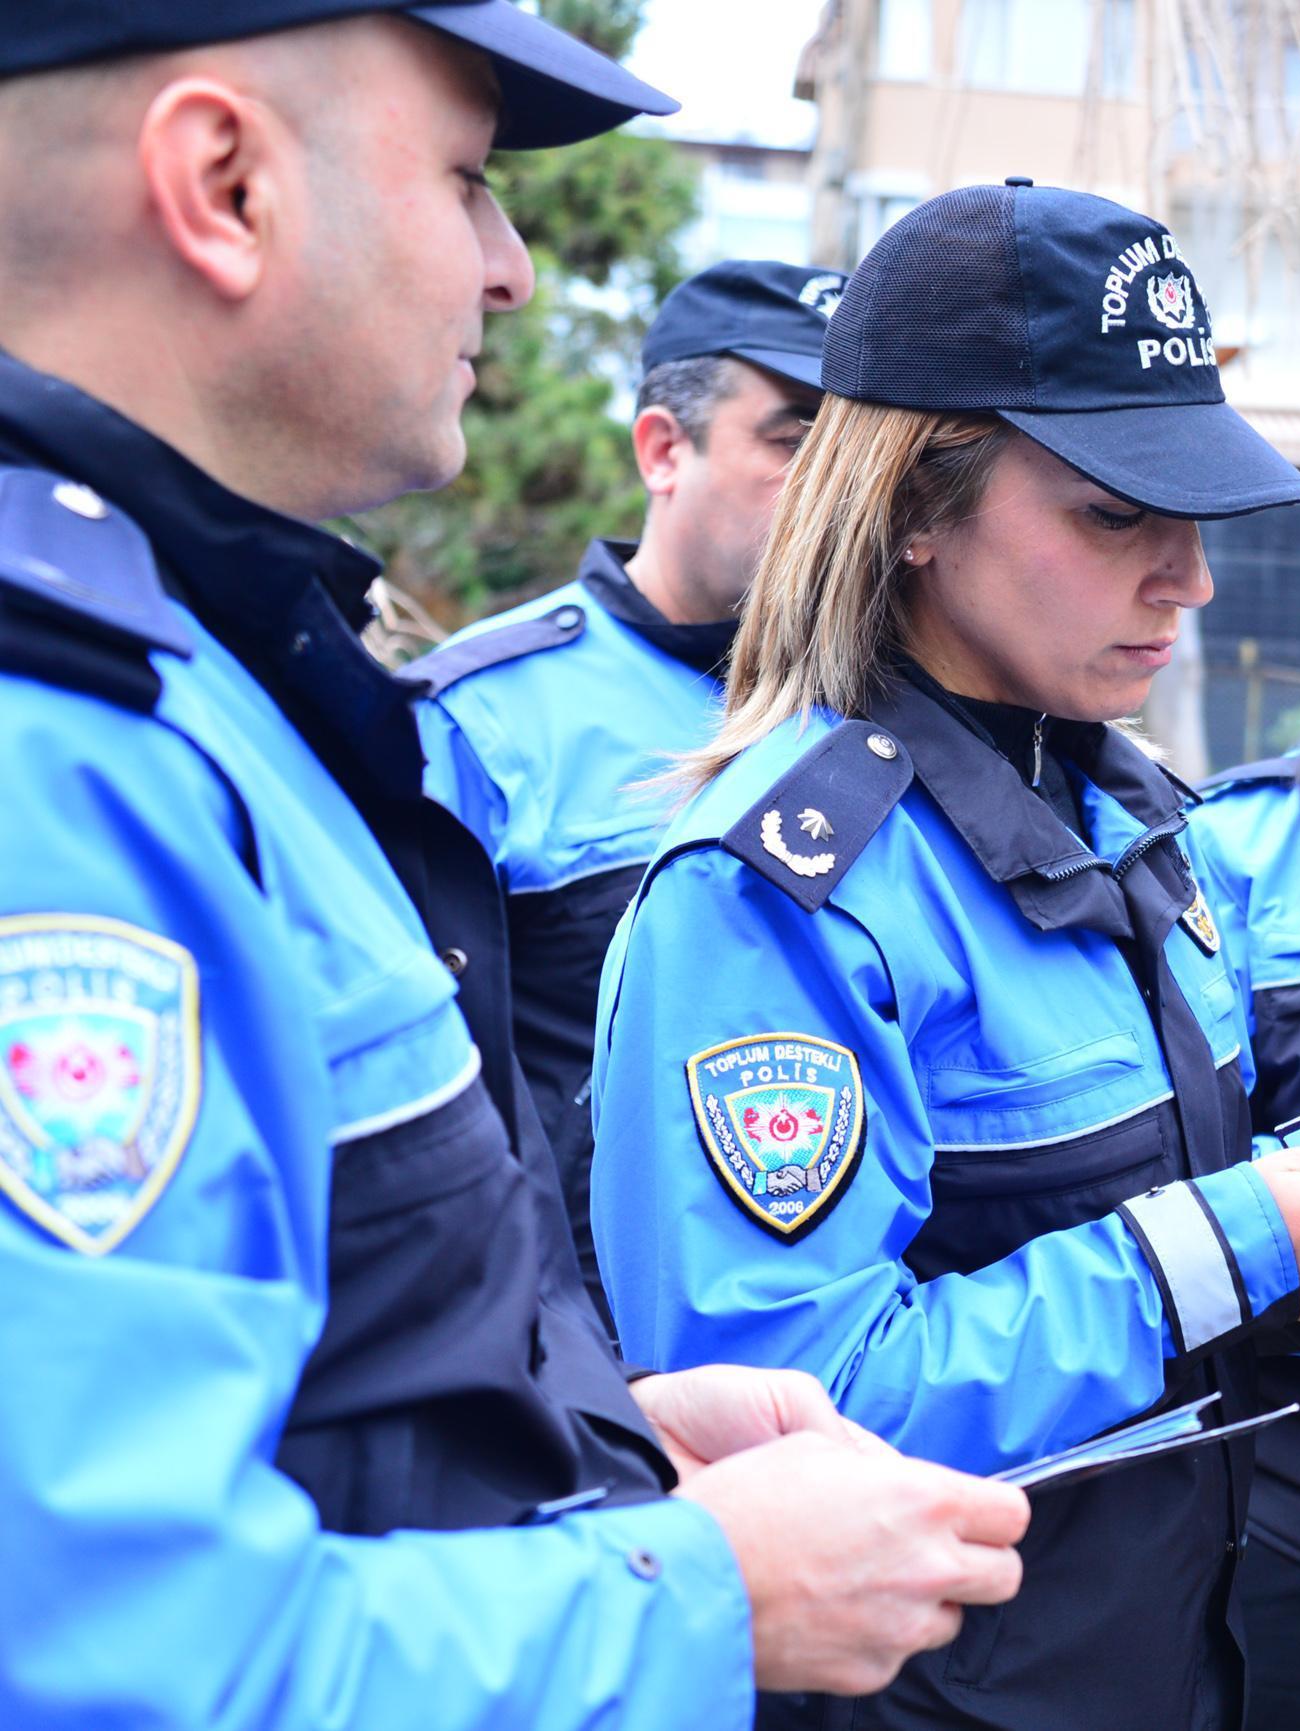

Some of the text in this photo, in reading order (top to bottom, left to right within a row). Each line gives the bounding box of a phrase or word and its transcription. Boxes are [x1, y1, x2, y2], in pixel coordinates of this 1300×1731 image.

[1101, 236, 1161, 334] TOPLUM
[1137, 327, 1217, 370] POLİS
[704, 1044, 843, 1078] TOPLUM DESTEKLİ
[740, 1062, 818, 1087] POLİS
